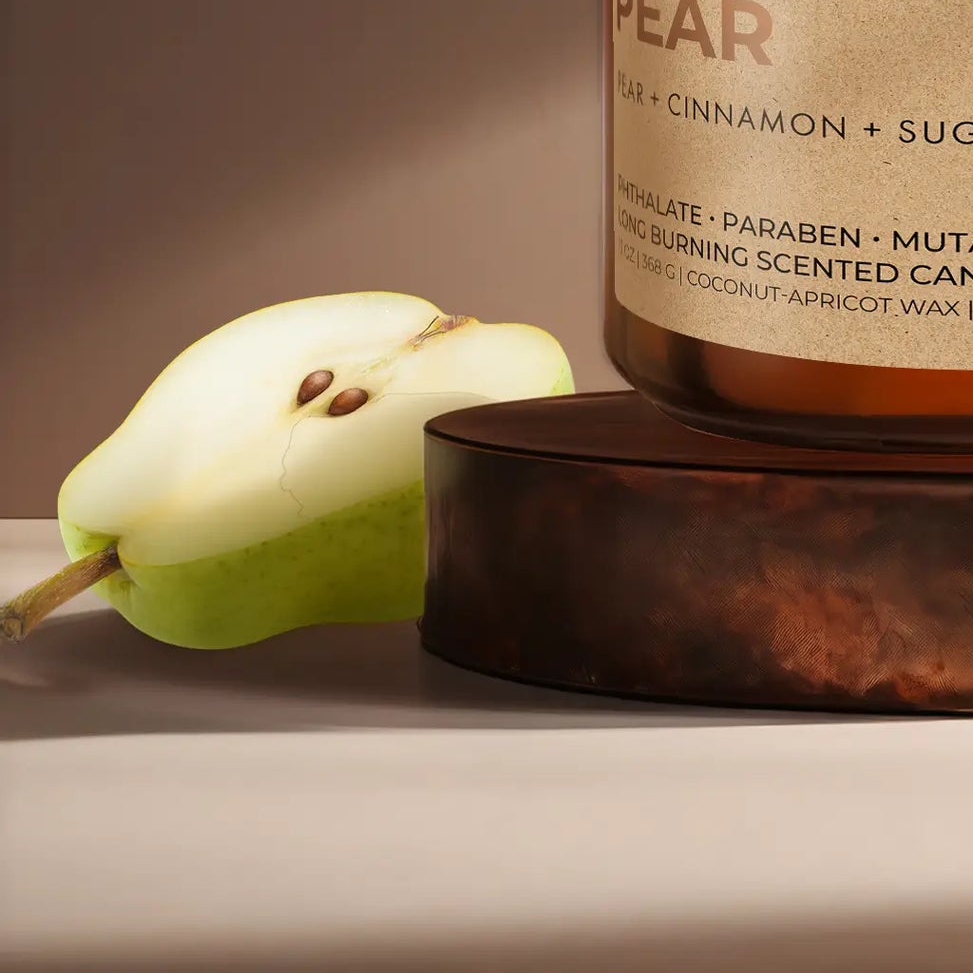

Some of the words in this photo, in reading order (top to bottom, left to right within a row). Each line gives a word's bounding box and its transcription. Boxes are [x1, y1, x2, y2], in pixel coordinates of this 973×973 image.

[667, 93, 846, 139] CINNAMON
[650, 224, 749, 268] BURNING
[756, 251, 899, 284] SCENTED
[723, 211, 861, 249] PARABEN
[641, 253, 662, 276] 368
[665, 263, 676, 280] G
[687, 270, 894, 314] COCONUT-APRICOT
[900, 298, 961, 317] WAX
